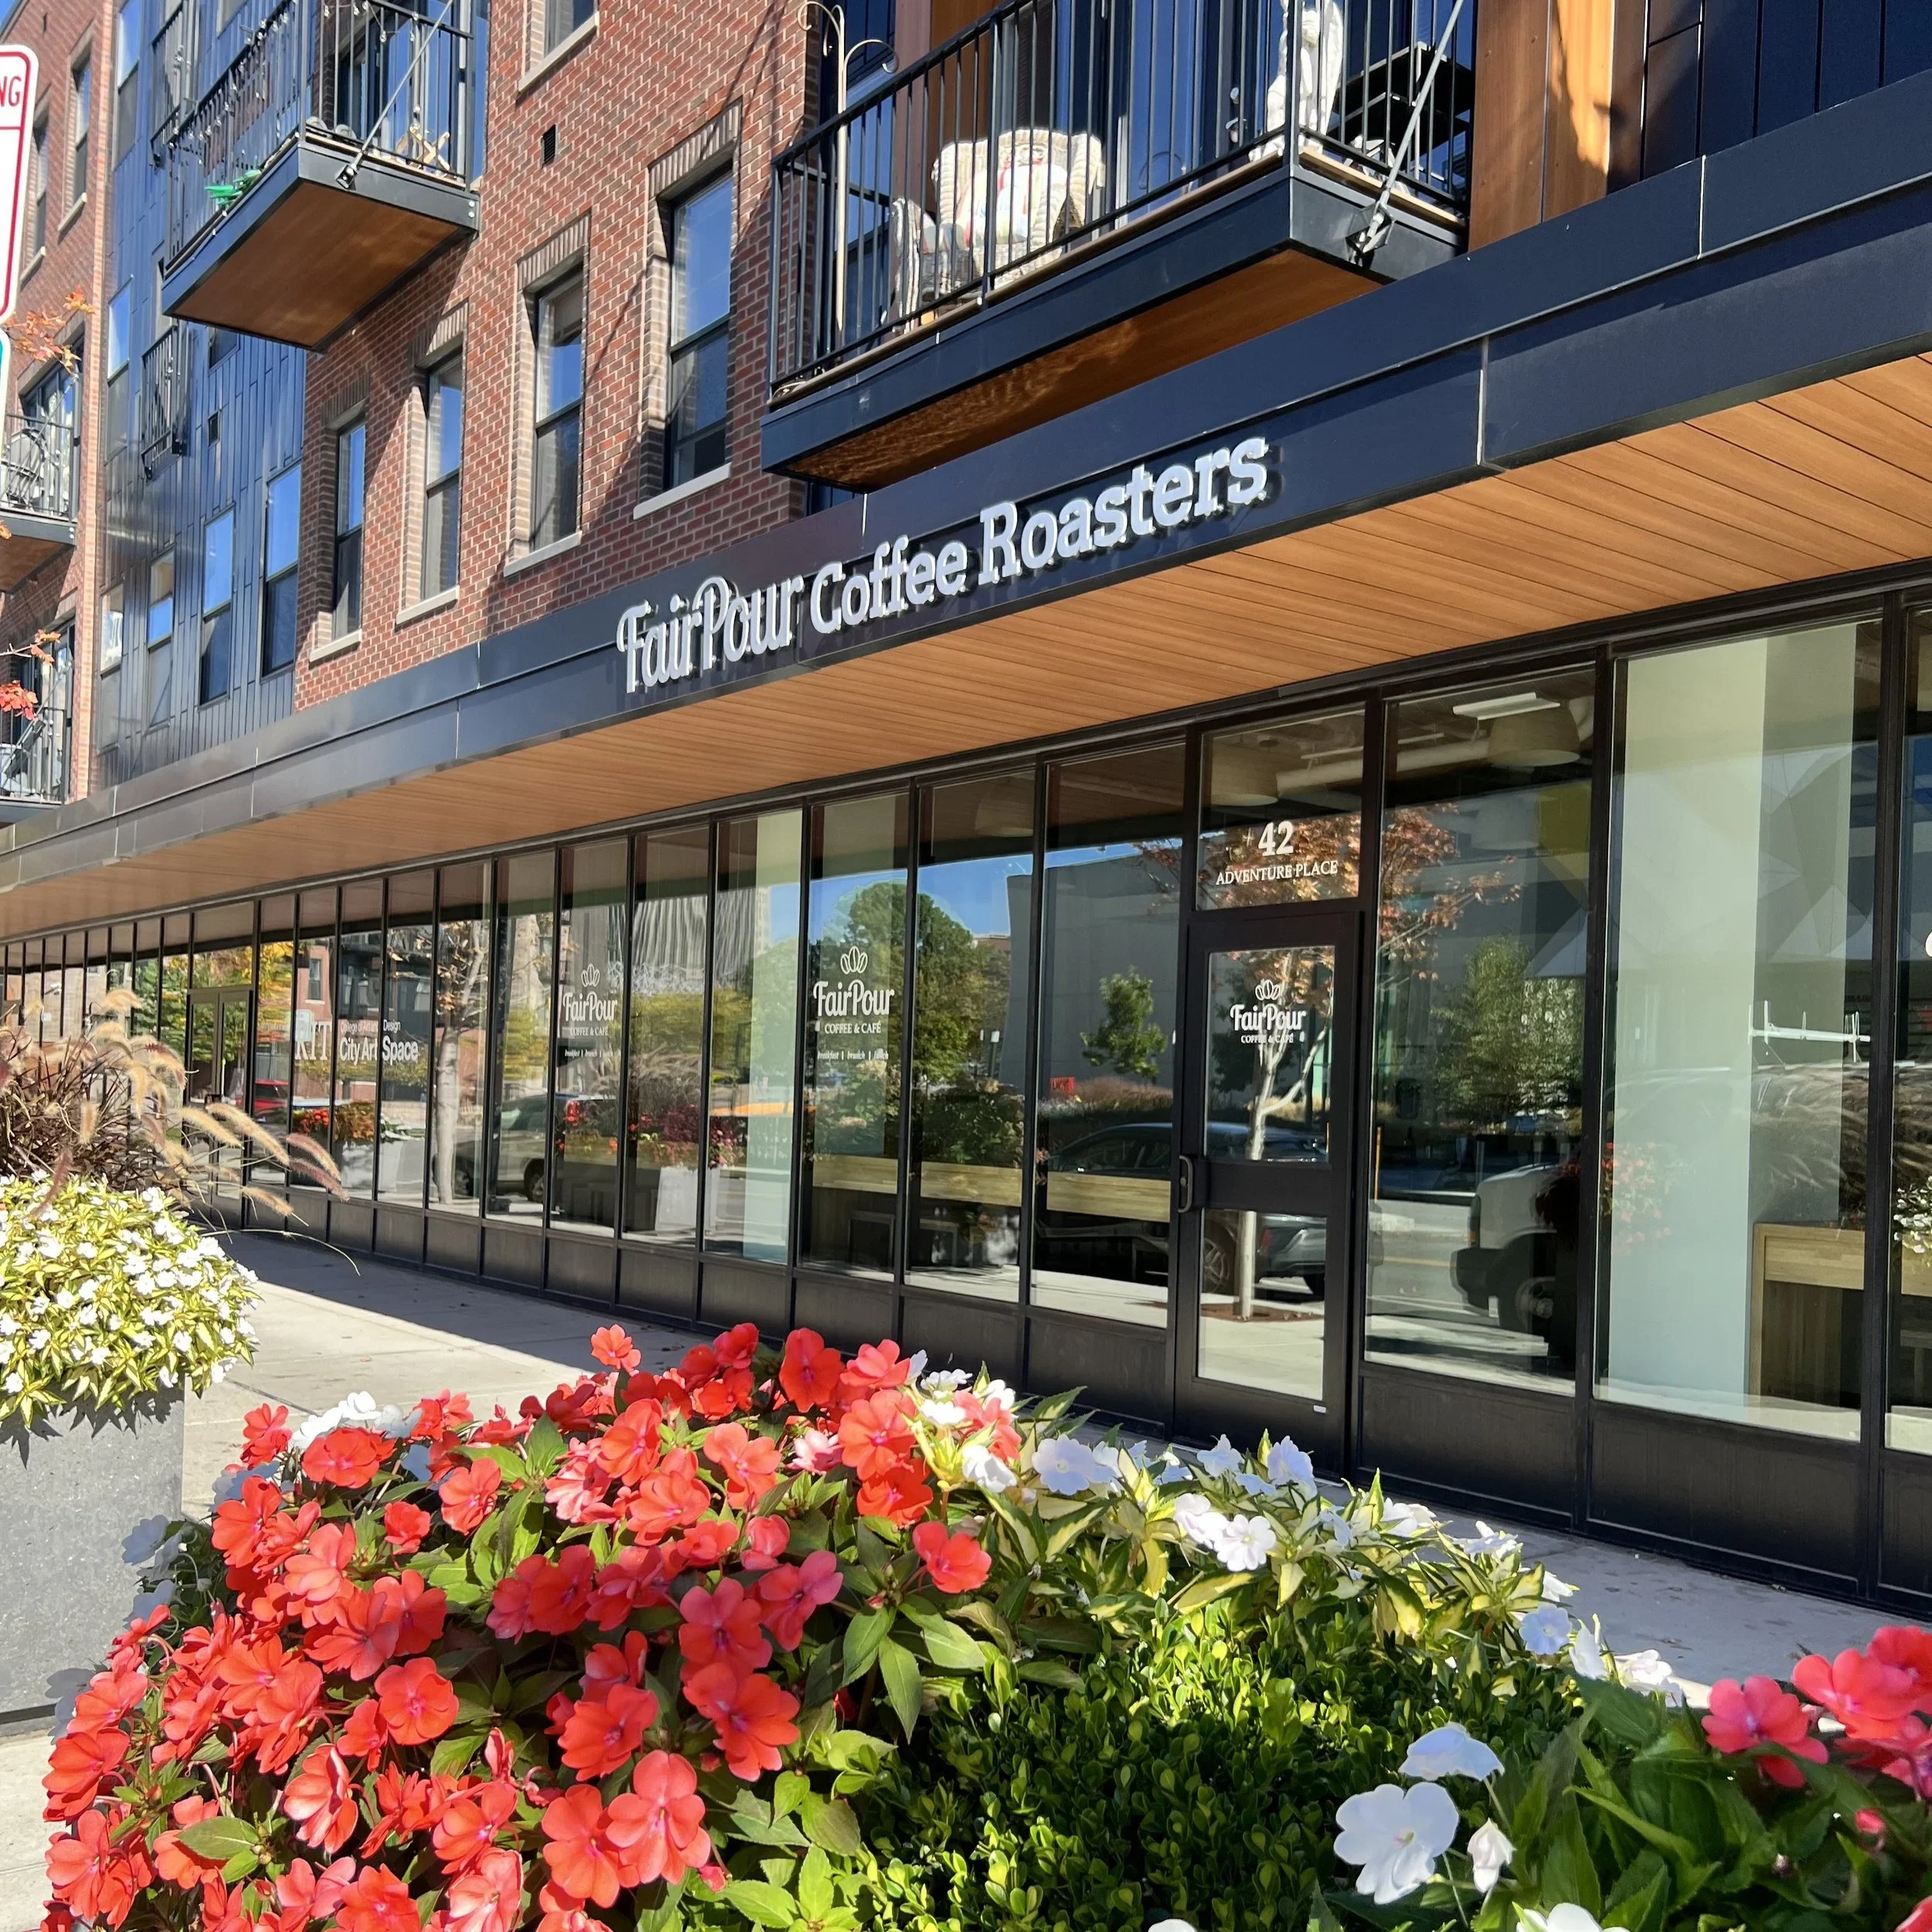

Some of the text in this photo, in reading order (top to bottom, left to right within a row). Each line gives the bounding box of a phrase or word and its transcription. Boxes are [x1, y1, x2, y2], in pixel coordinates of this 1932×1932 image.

[617, 437, 1269, 694] FairPour Coffee Roasters
[1258, 820, 1294, 856] 42
[1216, 860, 1338, 885] ADVENTURE PLACE
[563, 991, 617, 1022] FairPour
[813, 979, 895, 1016] FairPour
[383, 1019, 400, 1033] Design
[825, 1020, 881, 1034] COFFEE & CAFÉ
[1230, 1003, 1307, 1031] FairPour
[339, 1036, 419, 1065] City Art Space
